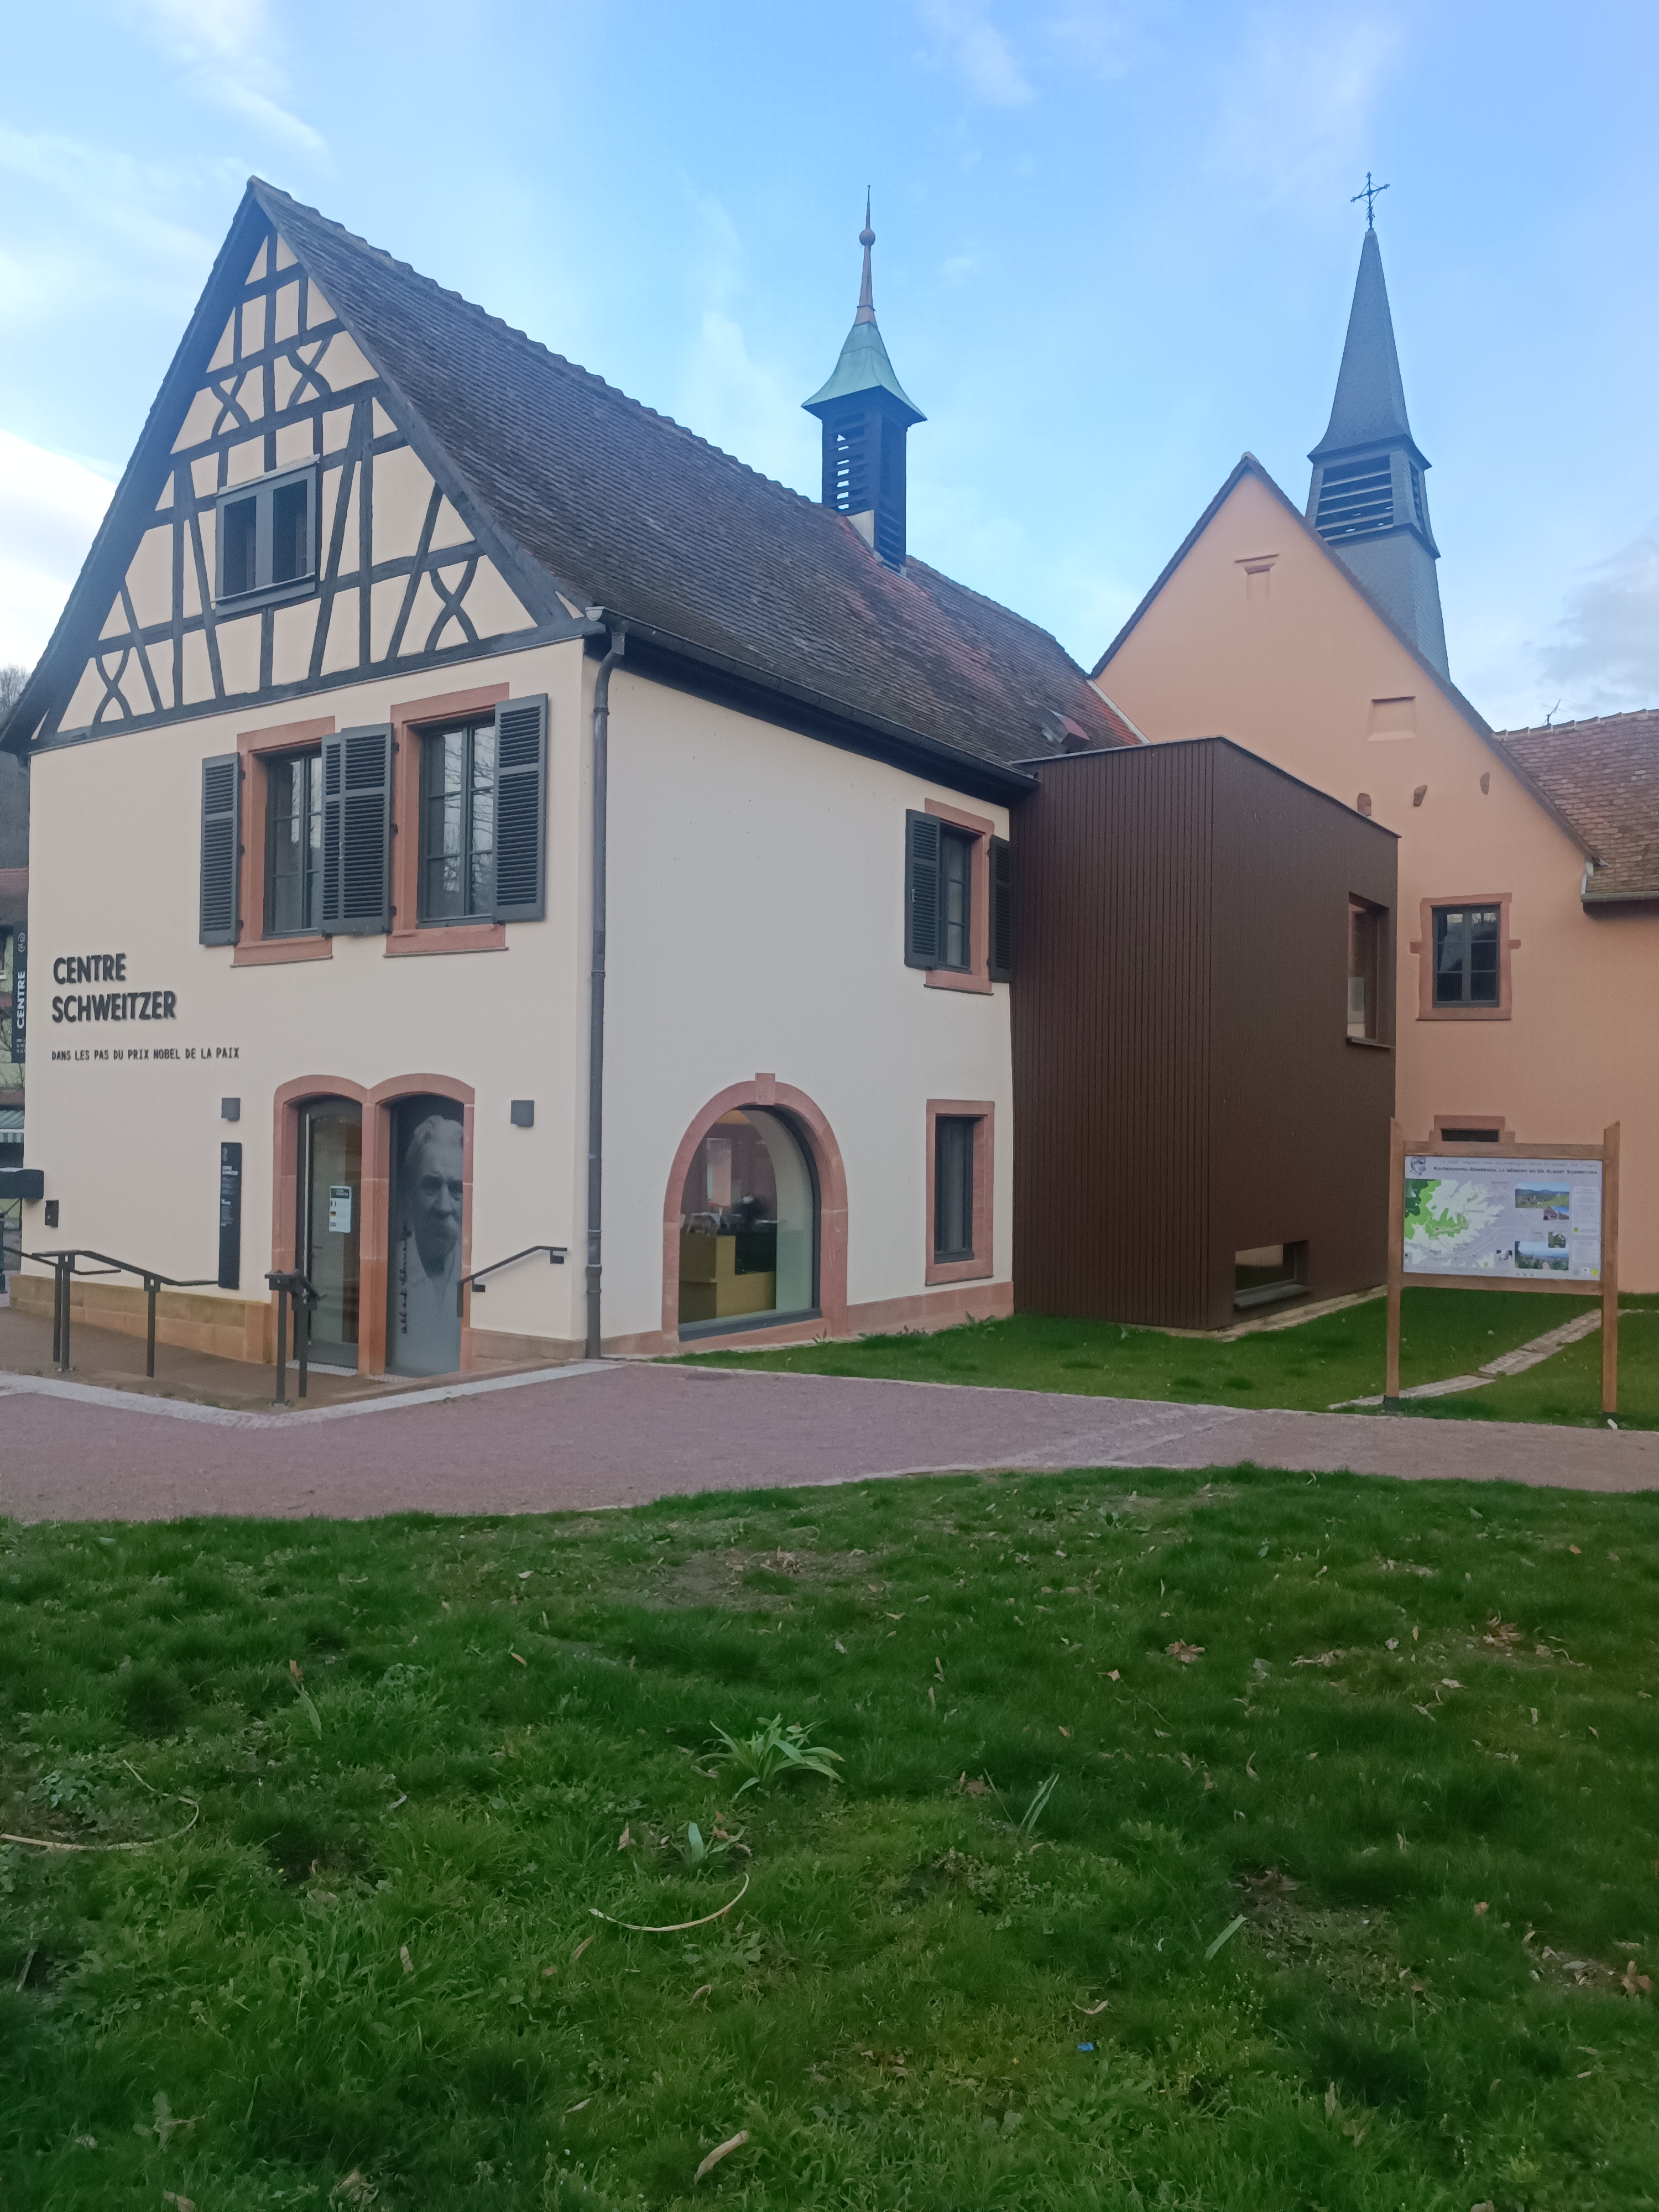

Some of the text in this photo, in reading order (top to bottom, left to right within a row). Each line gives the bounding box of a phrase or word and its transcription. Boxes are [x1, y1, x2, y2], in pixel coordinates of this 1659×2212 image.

[53, 952, 127, 984] CENTRE
[17, 970, 26, 1030] CENTRE
[52, 990, 177, 1022] SCHWEITZER
[51, 1047, 239, 1061] DANS LES PAS DU PRIX NOBEL DE LA PAIX
